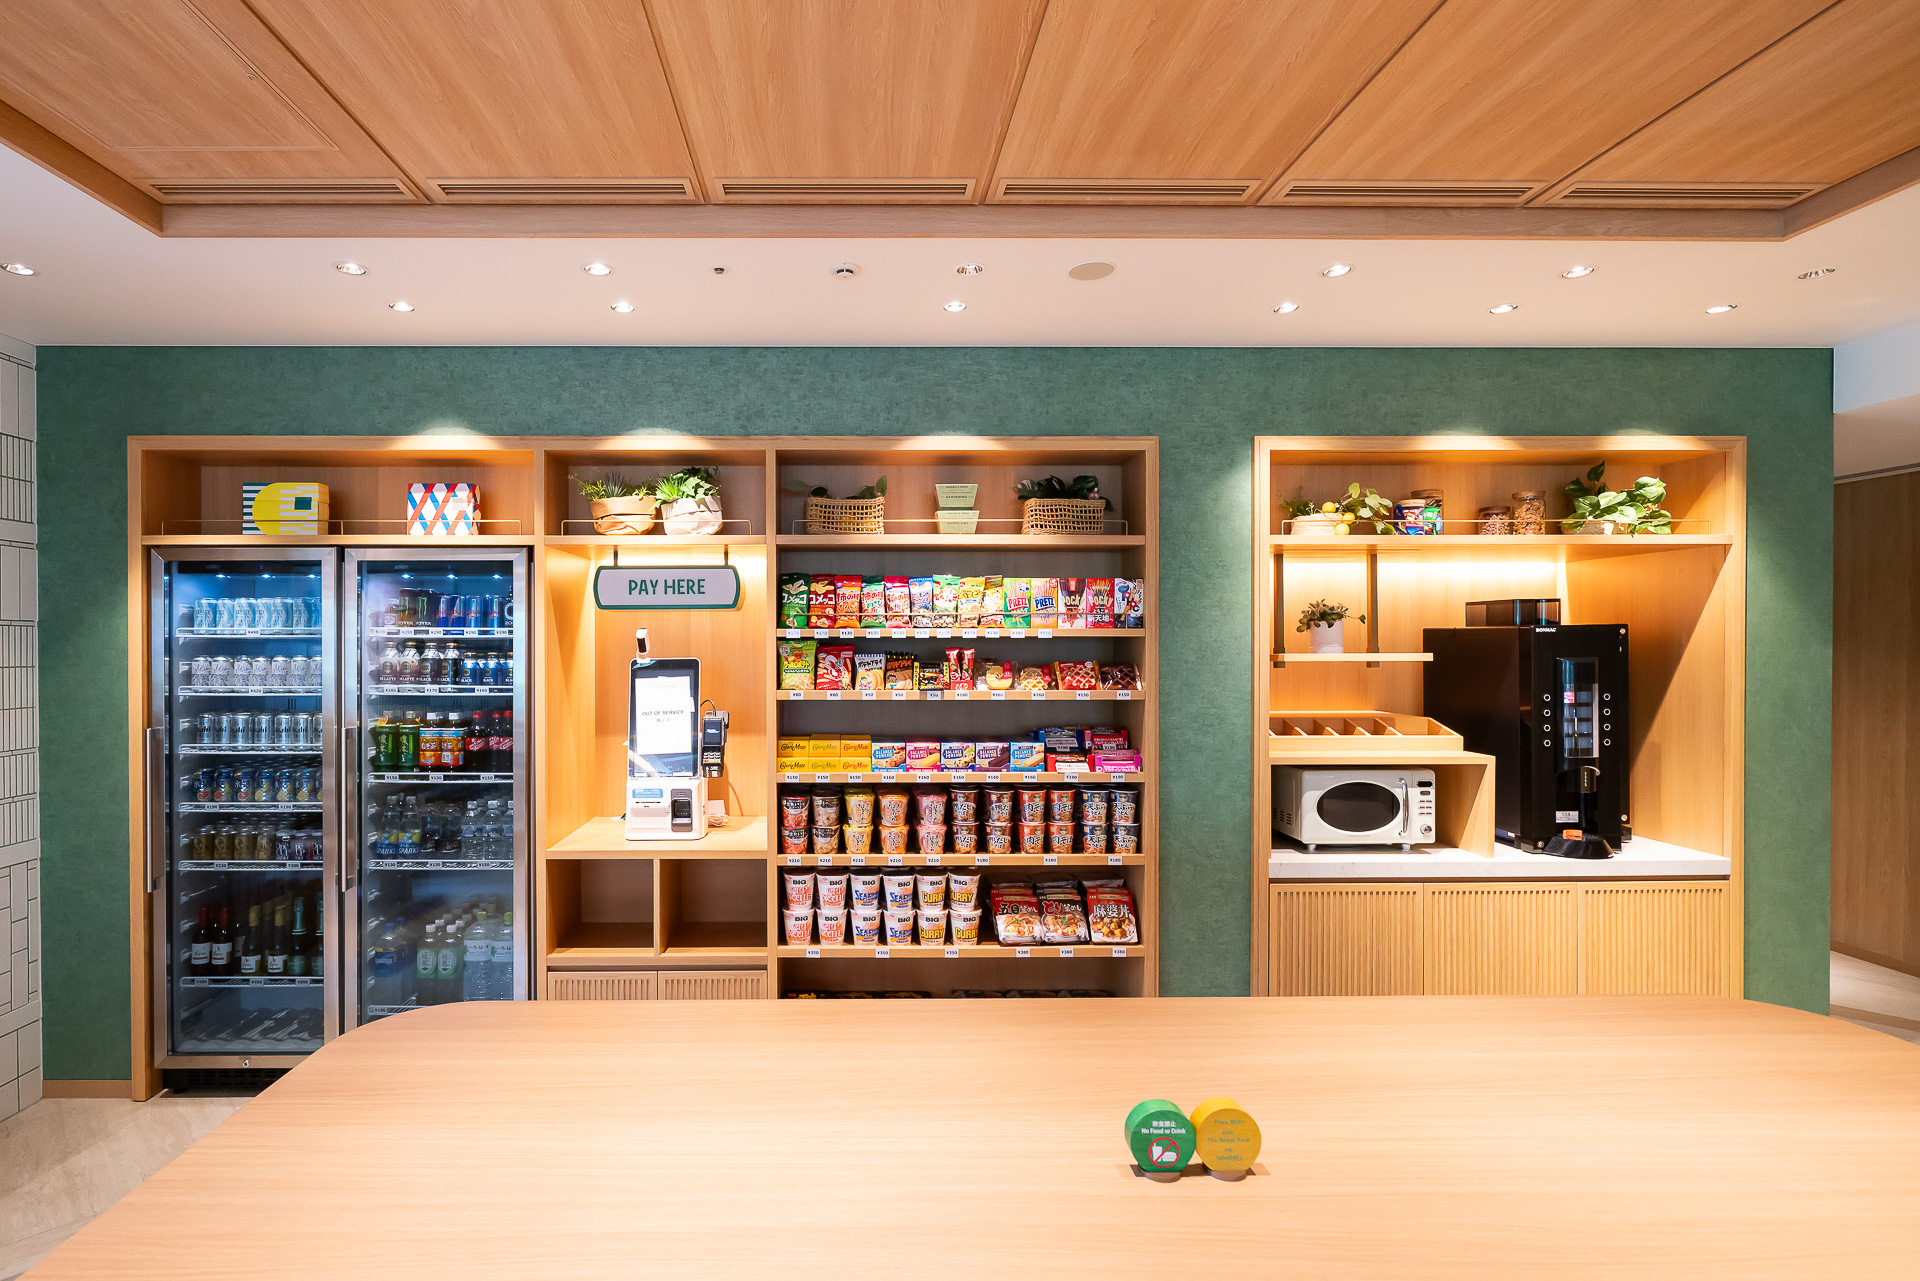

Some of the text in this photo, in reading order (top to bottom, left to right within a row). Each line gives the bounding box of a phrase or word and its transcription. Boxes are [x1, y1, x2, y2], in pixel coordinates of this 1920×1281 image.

[629, 579, 705, 595] PAY HERE
[782, 593, 807, 604] コメッコ
[809, 594, 835, 604] コメッコ
[1007, 597, 1028, 608] PRETZ
[1035, 598, 1055, 608] PRETZ
[858, 659, 882, 667] ポテトフライ
[1093, 904, 1130, 918] 麻婆丼
[920, 926, 944, 939] CURRY
